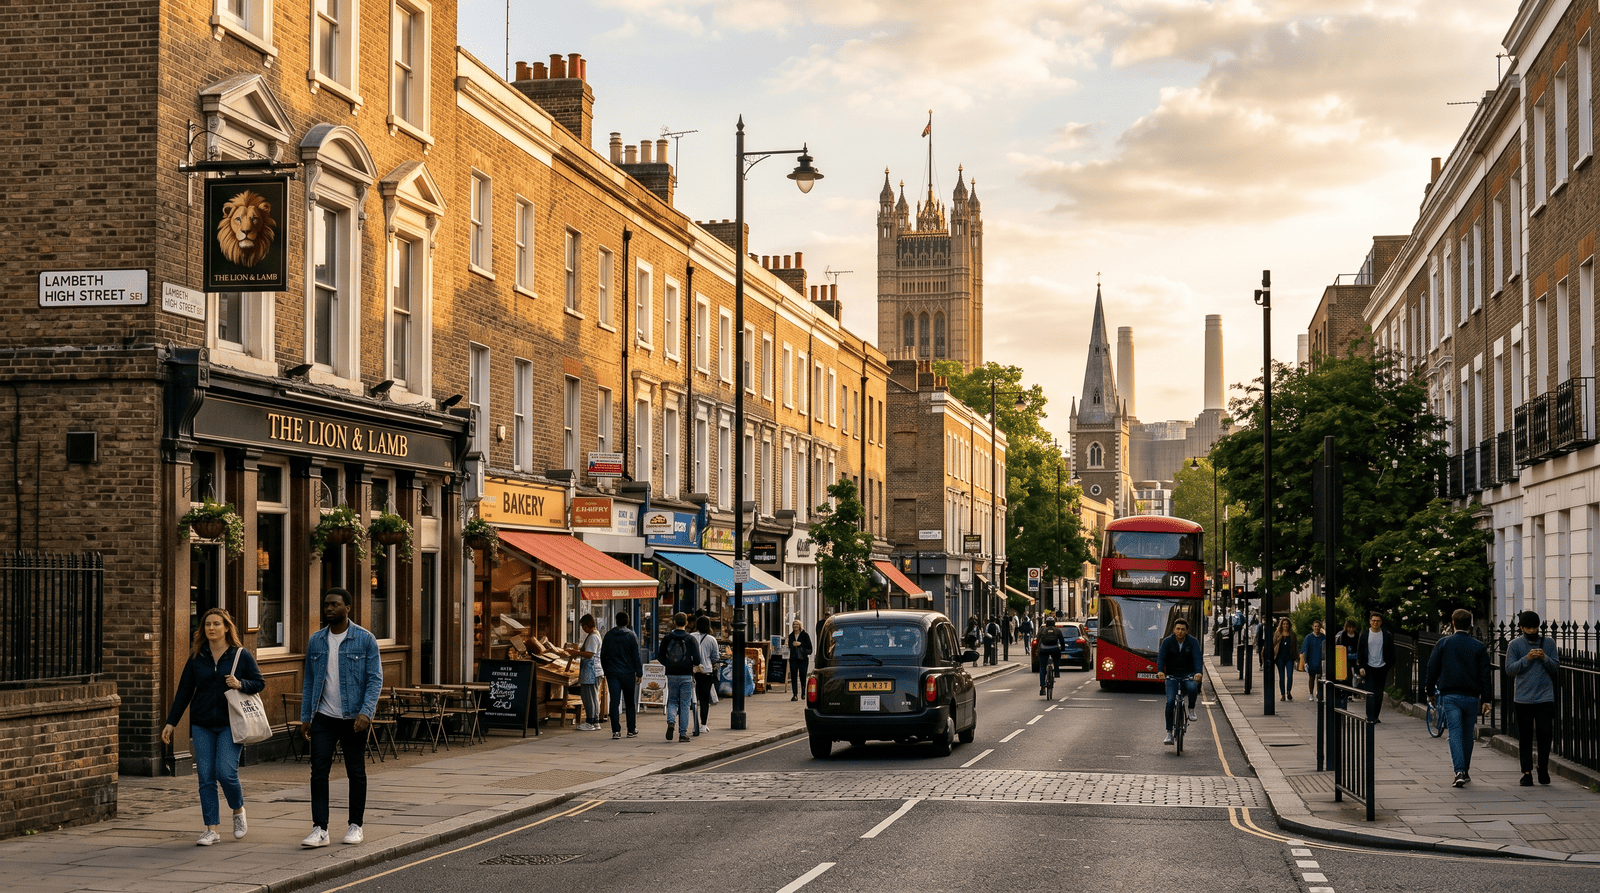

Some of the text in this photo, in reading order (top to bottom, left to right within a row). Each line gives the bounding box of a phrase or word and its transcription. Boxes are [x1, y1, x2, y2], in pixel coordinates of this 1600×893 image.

[45, 274, 104, 287] LAMBETH
[45, 289, 143, 302] HIGH STREET SE1
[165, 286, 188, 300] LAMBETH
[164, 298, 178, 309] HIGH
[179, 301, 196, 314] STREET
[267, 413, 408, 457] THE LION & LAMB
[503, 492, 545, 517] BAKERY
[1169, 575, 1186, 586] 159
